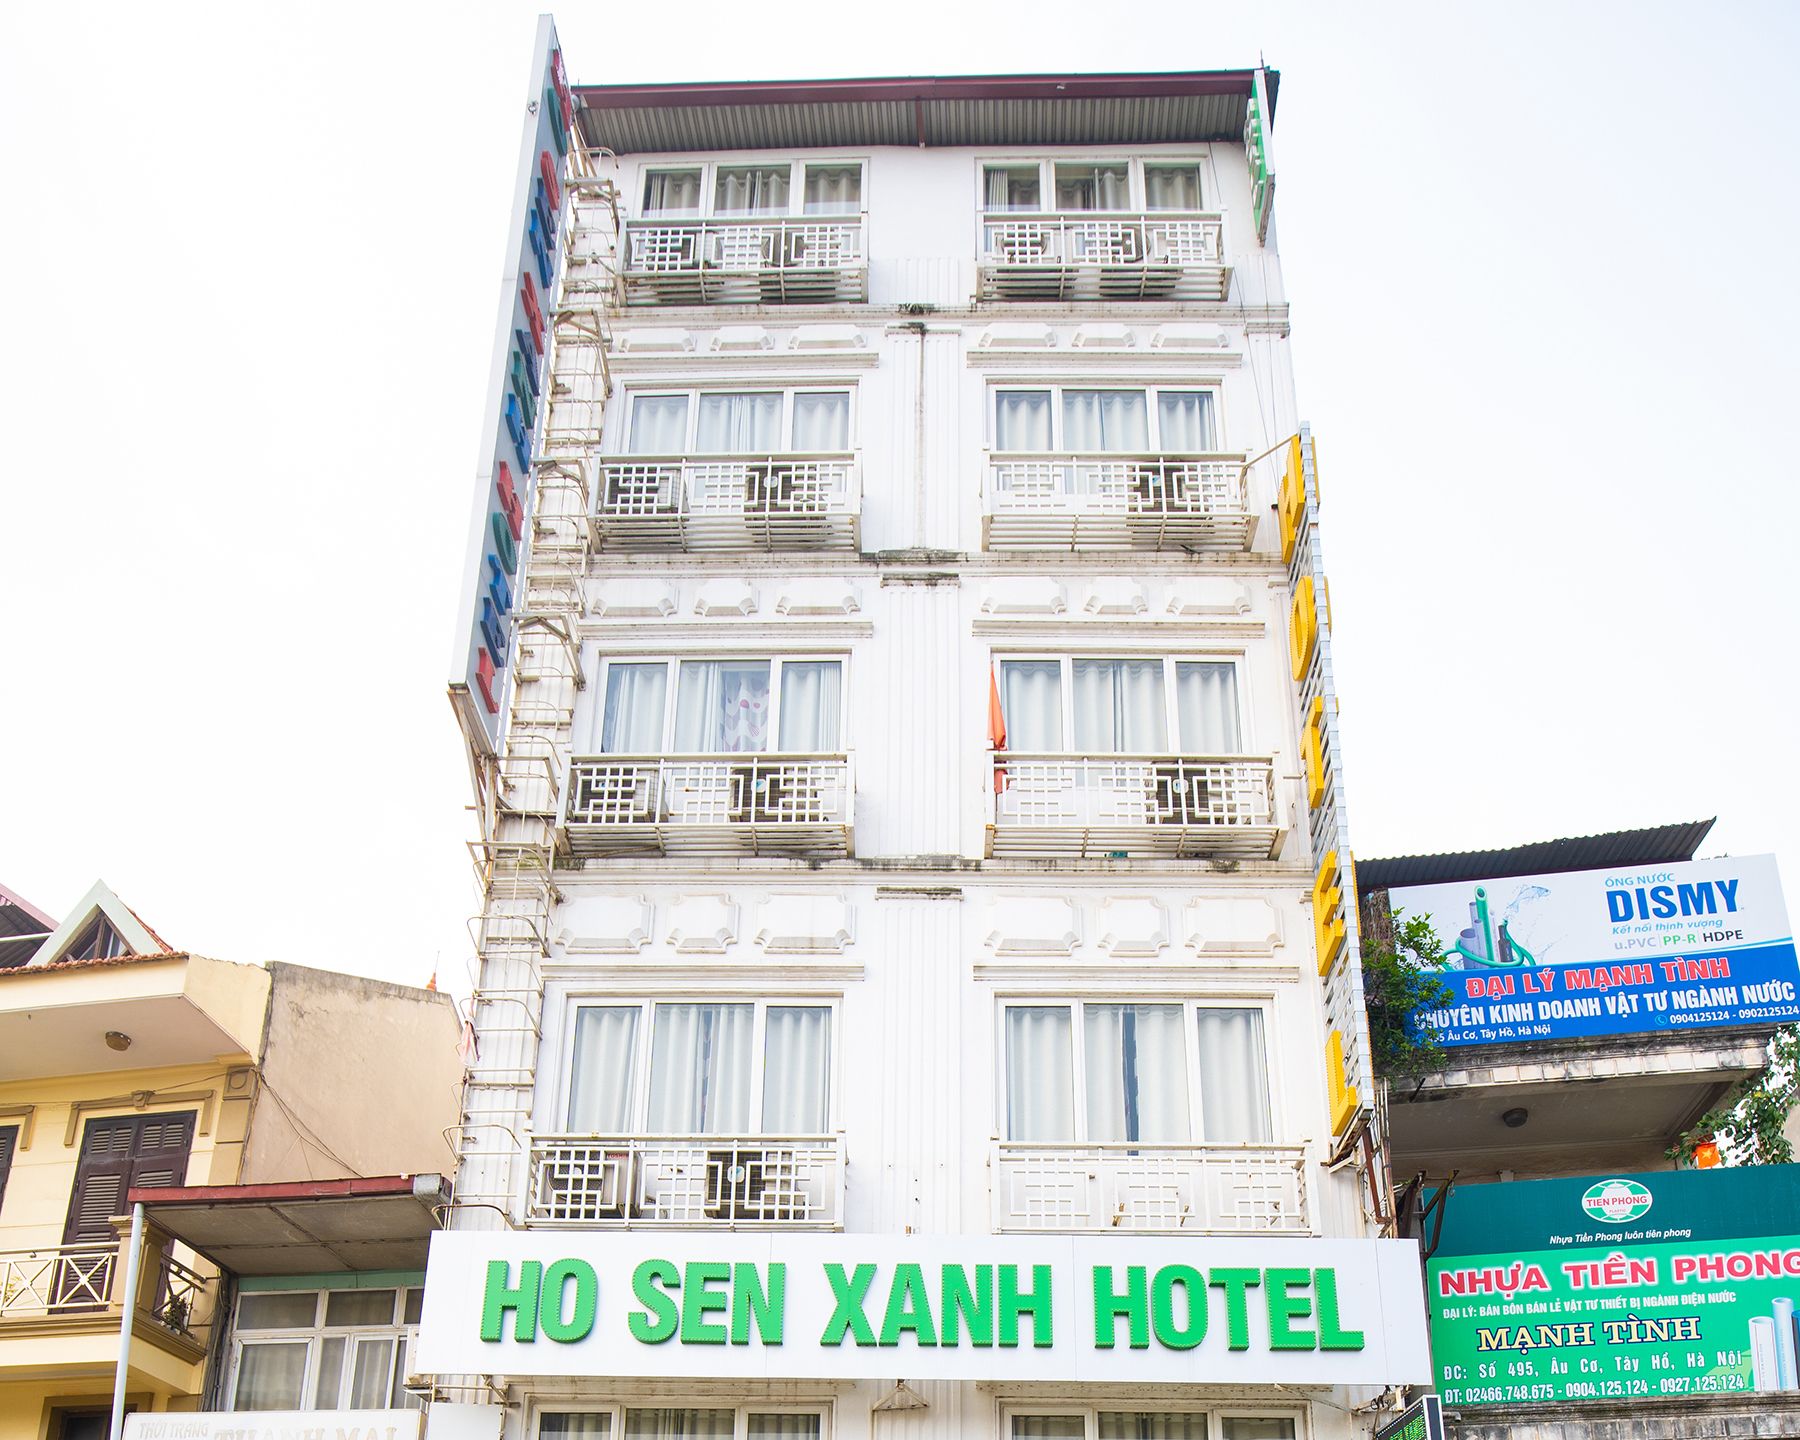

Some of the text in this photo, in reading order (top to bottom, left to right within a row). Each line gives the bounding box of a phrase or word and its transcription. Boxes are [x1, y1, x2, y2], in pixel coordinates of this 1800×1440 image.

[1279, 433, 1357, 1138] HOTEL
[1606, 879, 1740, 923] DISMY
[1663, 930, 1744, 946] PP-R HDPE
[1465, 956, 1731, 1001] ĐẠI LÝ MẠNH TÌNH
[1489, 979, 1797, 1024] KINH DOANH VẬT TƯ NGÀNH NƯỚC
[1669, 1005, 1800, 1024] 0904125124 0902125124
[1611, 1196, 1648, 1206] PHONG
[1550, 1228, 1691, 1246] Nhựa Phong luôn phong
[1440, 1250, 1800, 1298] NHỰA TIỀN PHONG
[480, 1257, 1365, 1351] HO SEN XANH HOTEL
[1443, 1290, 1737, 1320] ĐẠI BÁN BÁN VẬT THIẾT NGÀNH NƯỚC
[1476, 1312, 1703, 1355] MẠNH TÌNH
[1443, 1350, 1742, 1380] ĐC: Số 495, Âu Tây Hà Nội
[1445, 1375, 1744, 1403] ĐT: 02466.748.675 0904.125.124 0927.125.124
